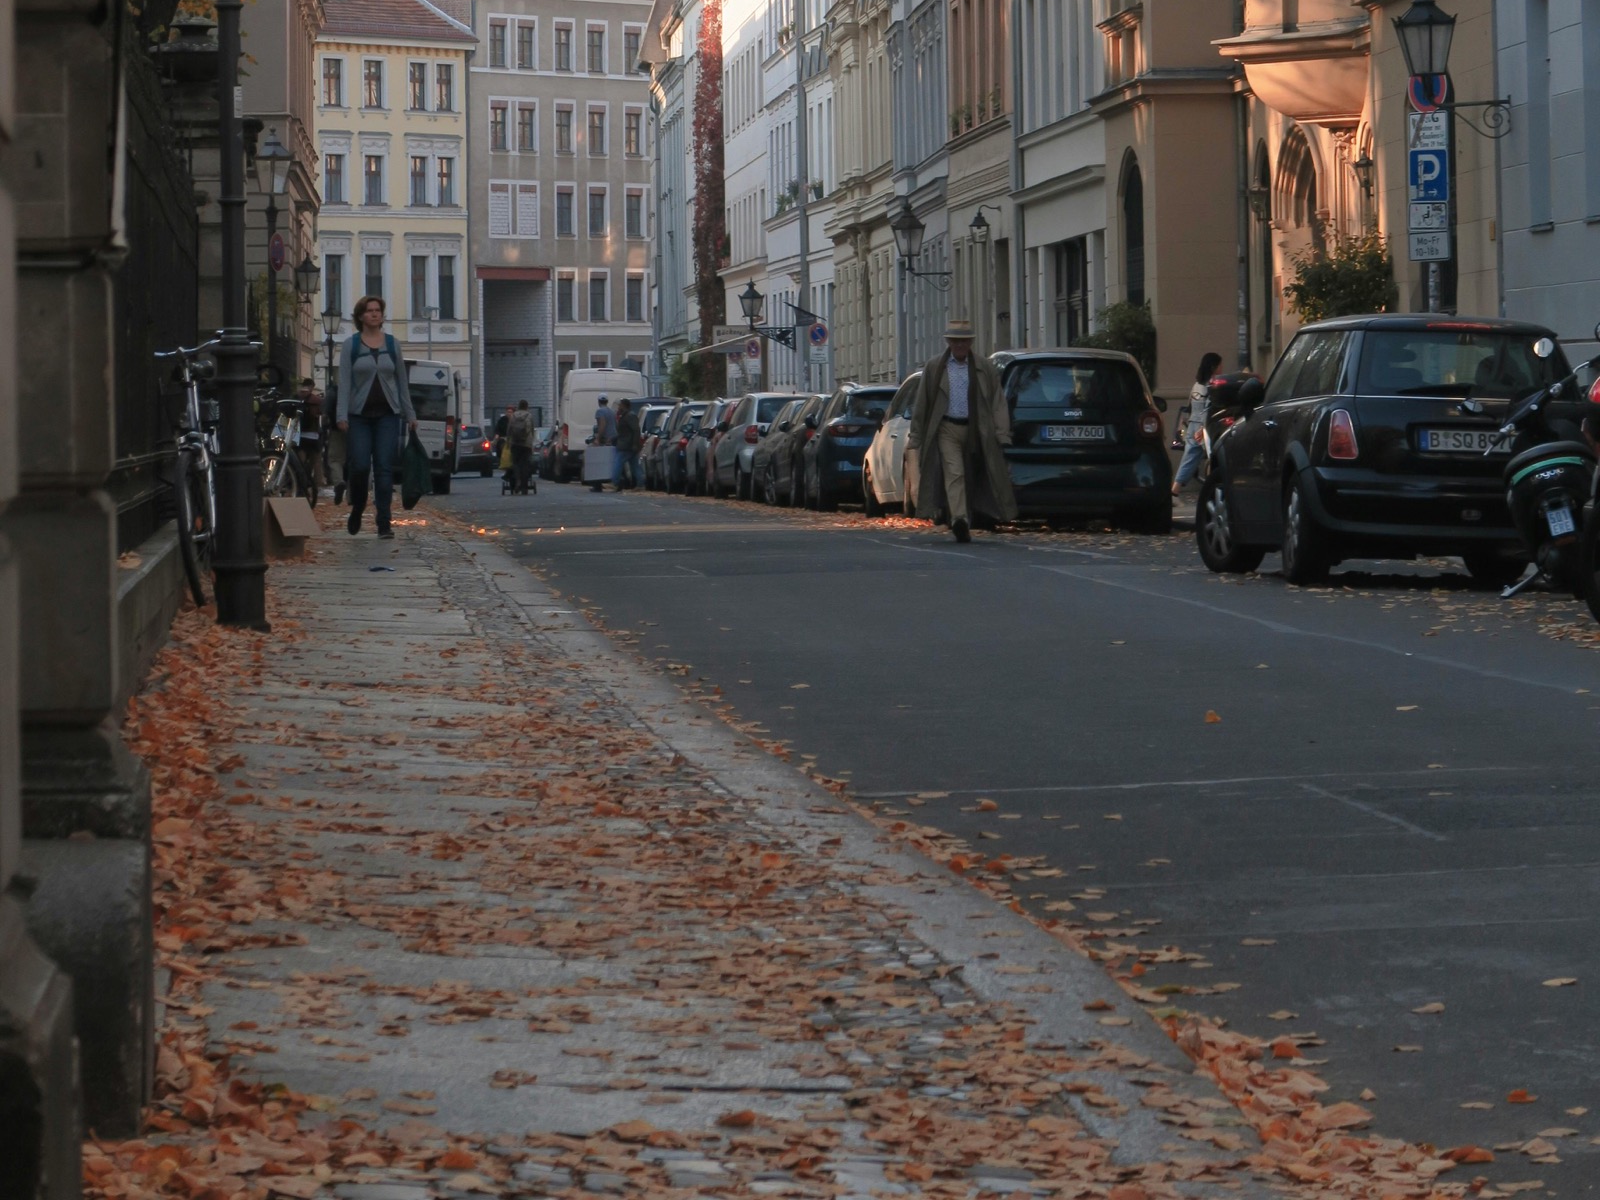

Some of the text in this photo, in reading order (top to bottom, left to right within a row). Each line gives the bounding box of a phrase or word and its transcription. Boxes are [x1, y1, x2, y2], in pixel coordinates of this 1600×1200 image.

[1417, 154, 1440, 197] P
[1416, 235, 1440, 246] Mo-Fr
[1047, 426, 1104, 438] B NR 7600
[1430, 432, 1440, 448] B
[1452, 432, 1474, 448] SQ
